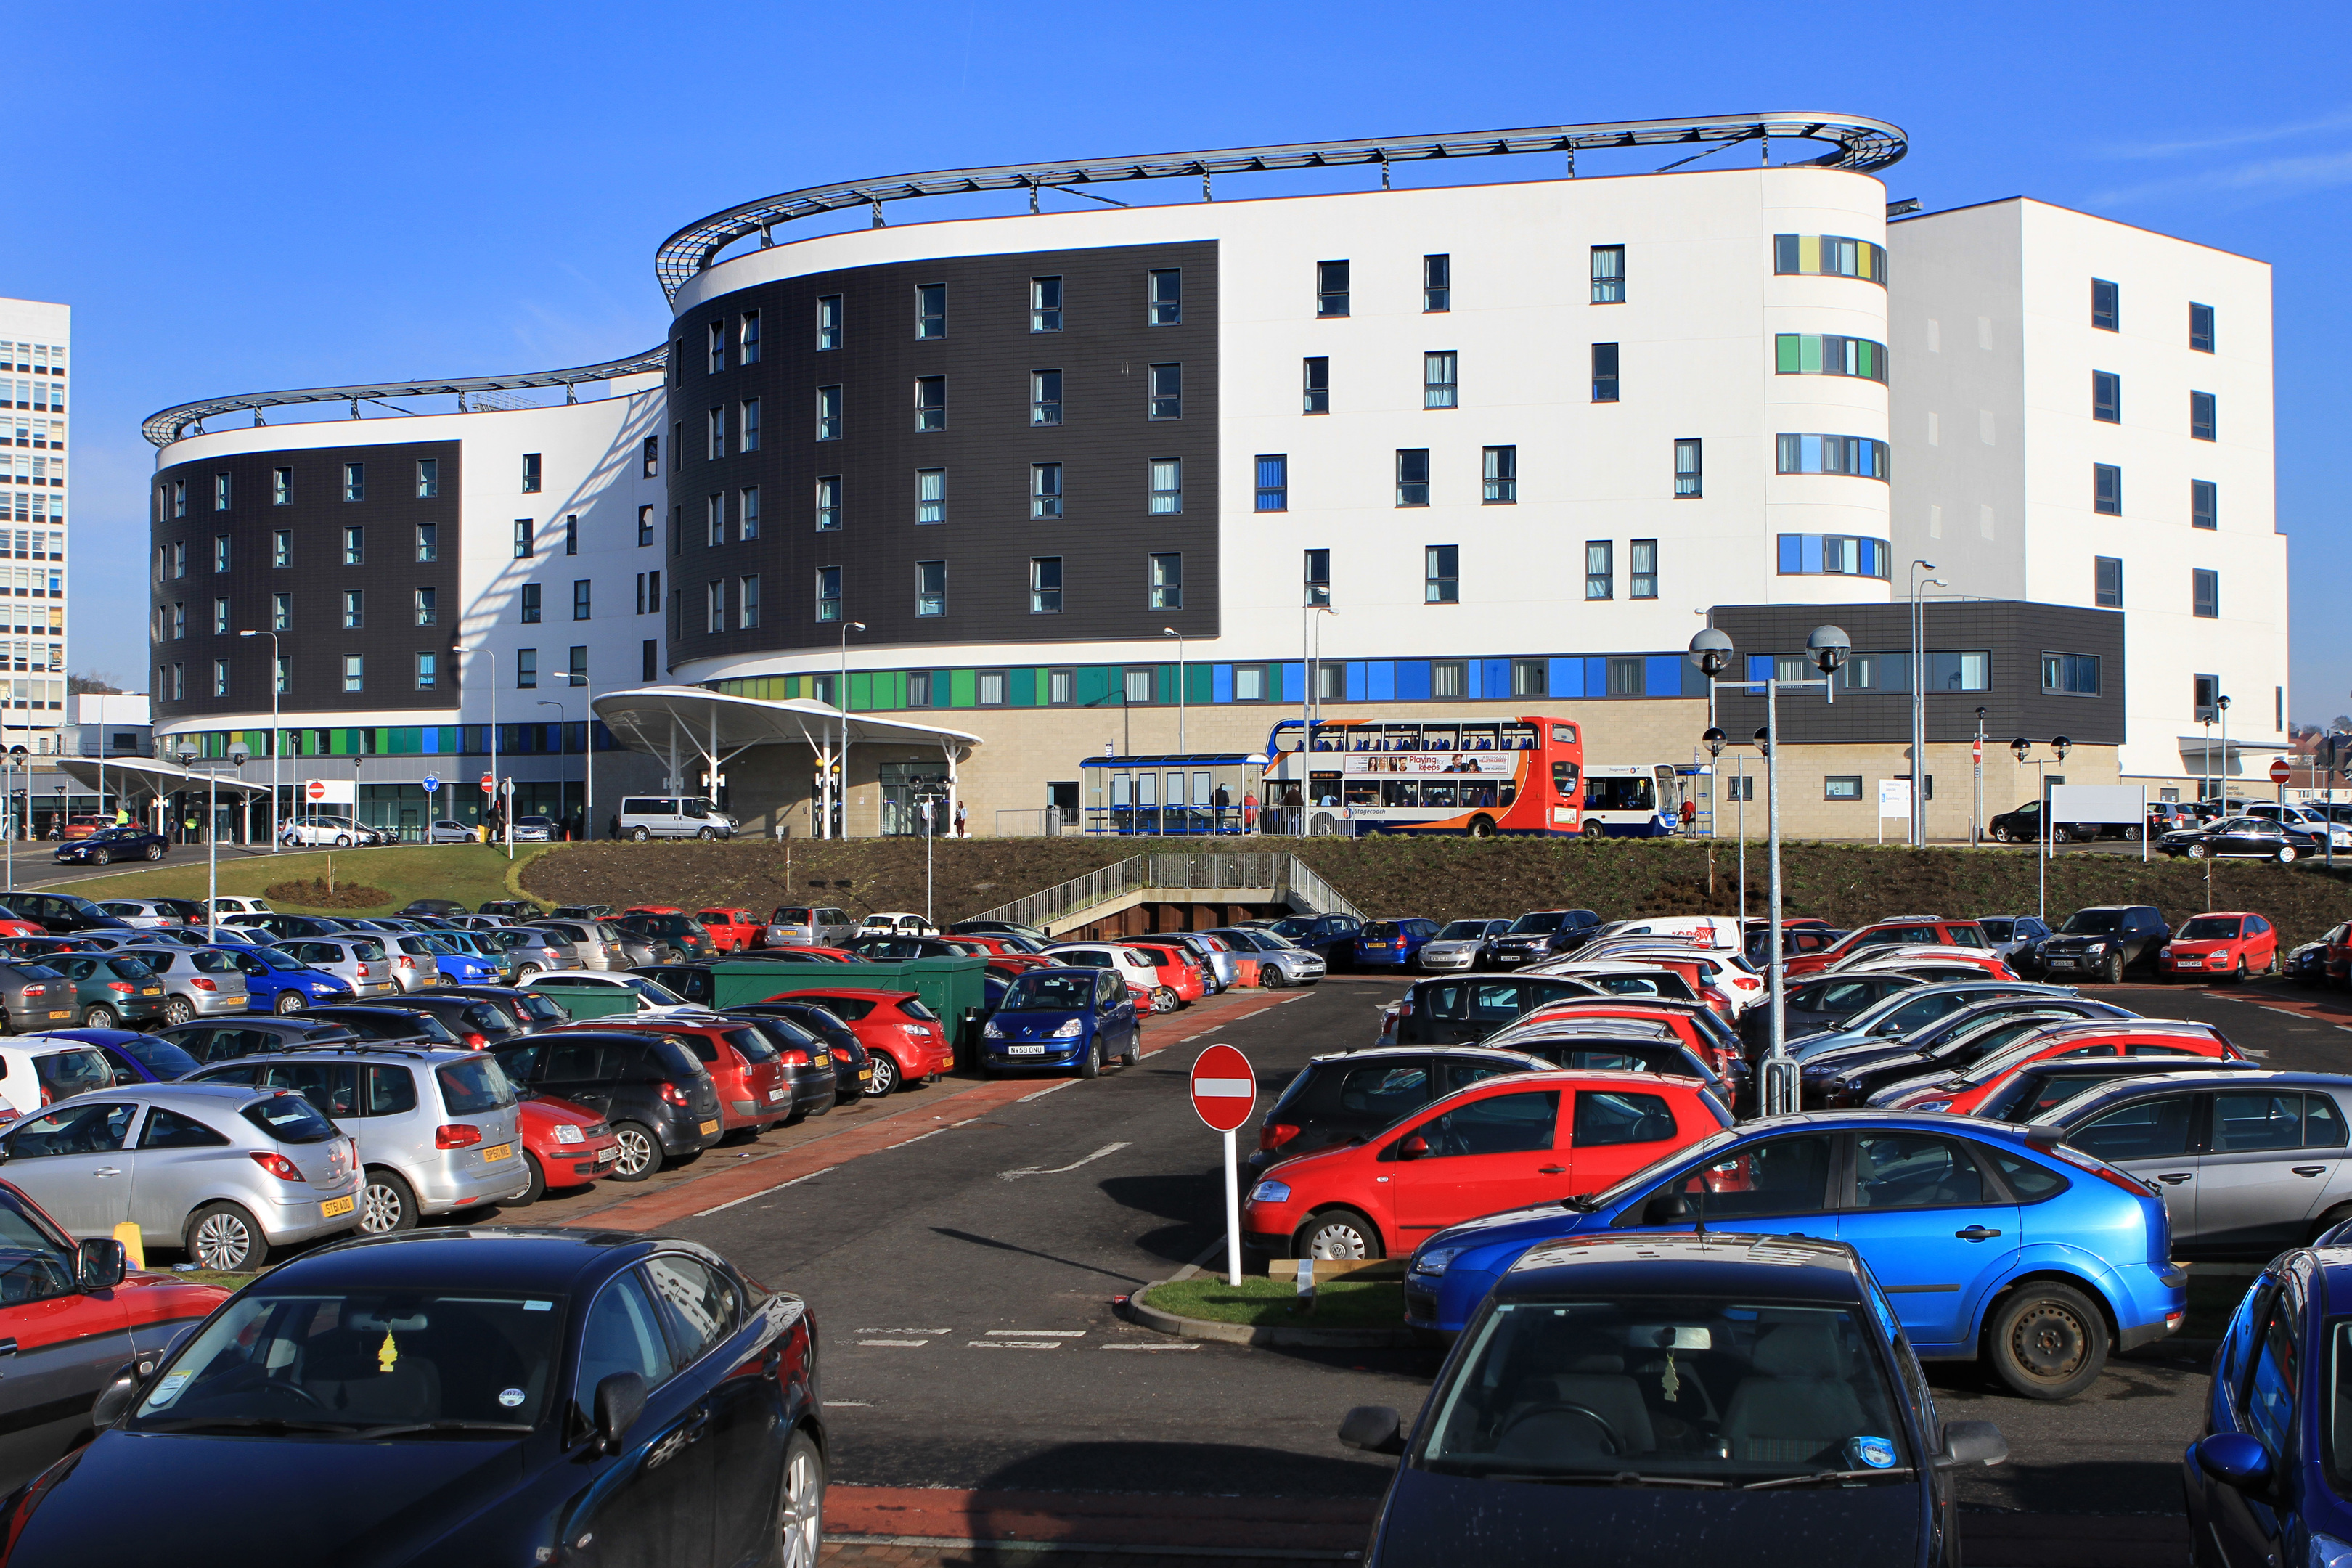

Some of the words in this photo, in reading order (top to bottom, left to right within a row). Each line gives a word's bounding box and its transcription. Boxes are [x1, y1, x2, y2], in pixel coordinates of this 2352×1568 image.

[1409, 756, 1437, 765] Playing
[486, 1148, 500, 1160] SP60
[325, 1201, 340, 1214] ST61
